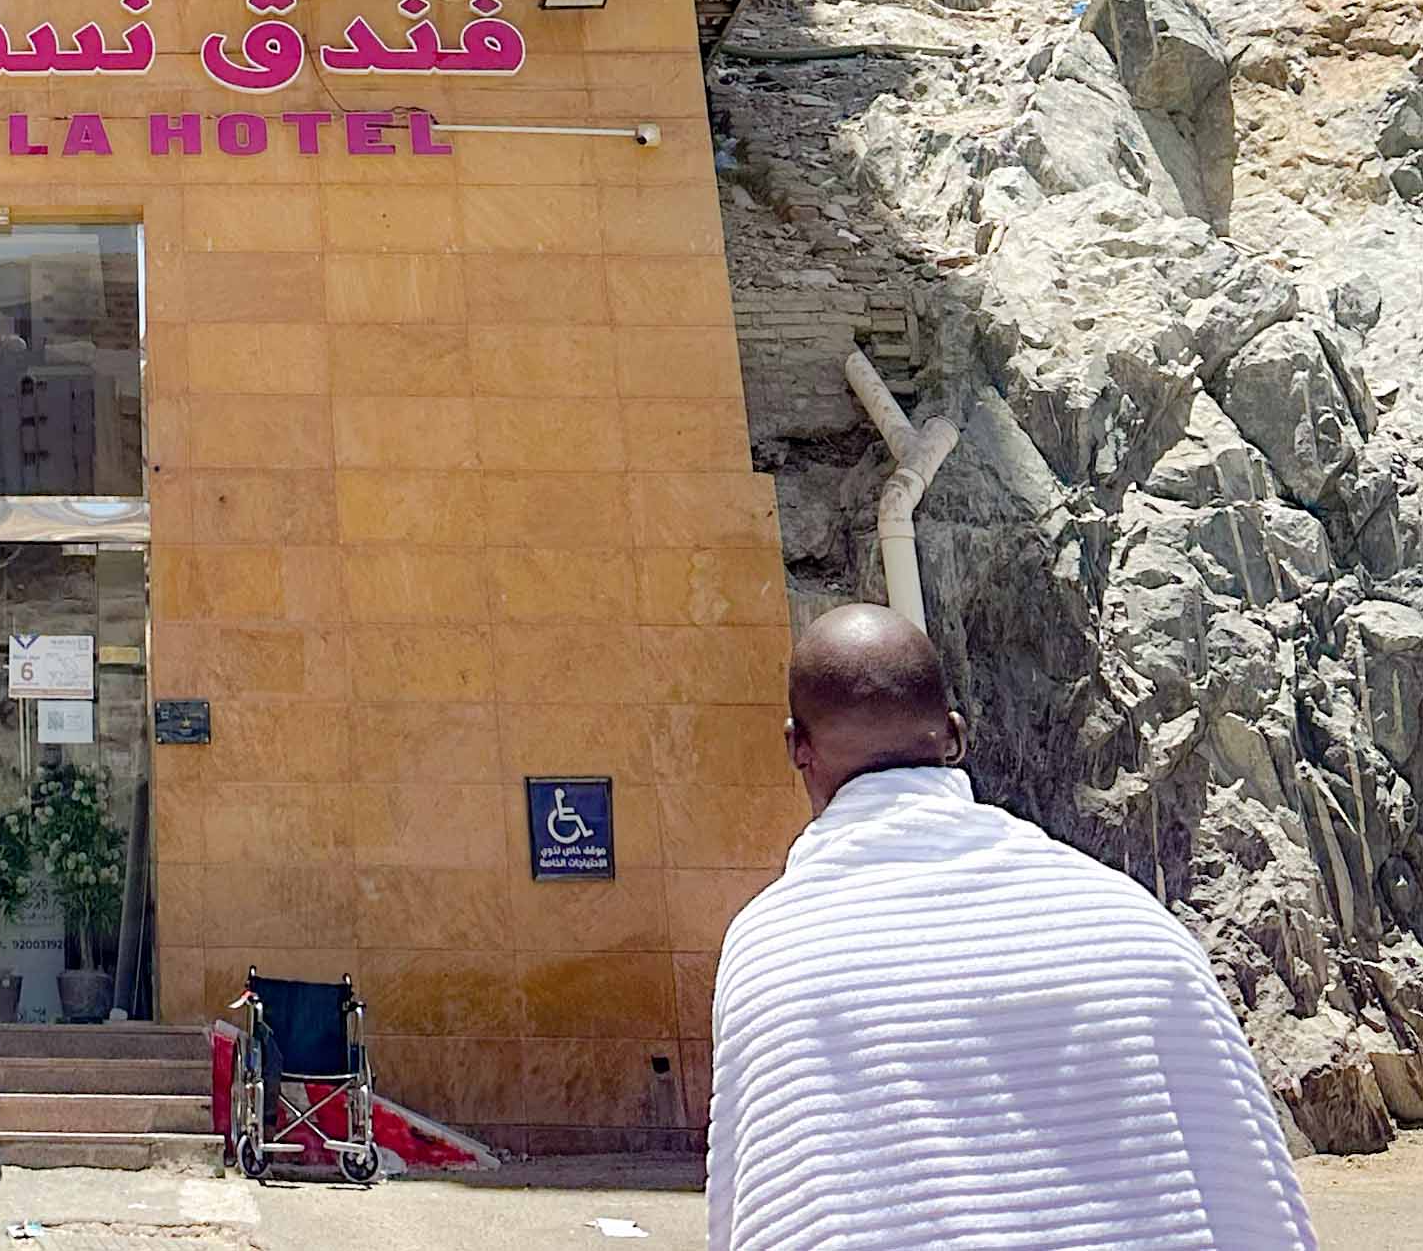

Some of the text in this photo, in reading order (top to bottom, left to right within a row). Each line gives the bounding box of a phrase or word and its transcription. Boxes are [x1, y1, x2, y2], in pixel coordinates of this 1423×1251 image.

[147, 111, 454, 157] HOTEL
[21, 662, 33, 681] 6
[562, 846, 581, 856] خاص
